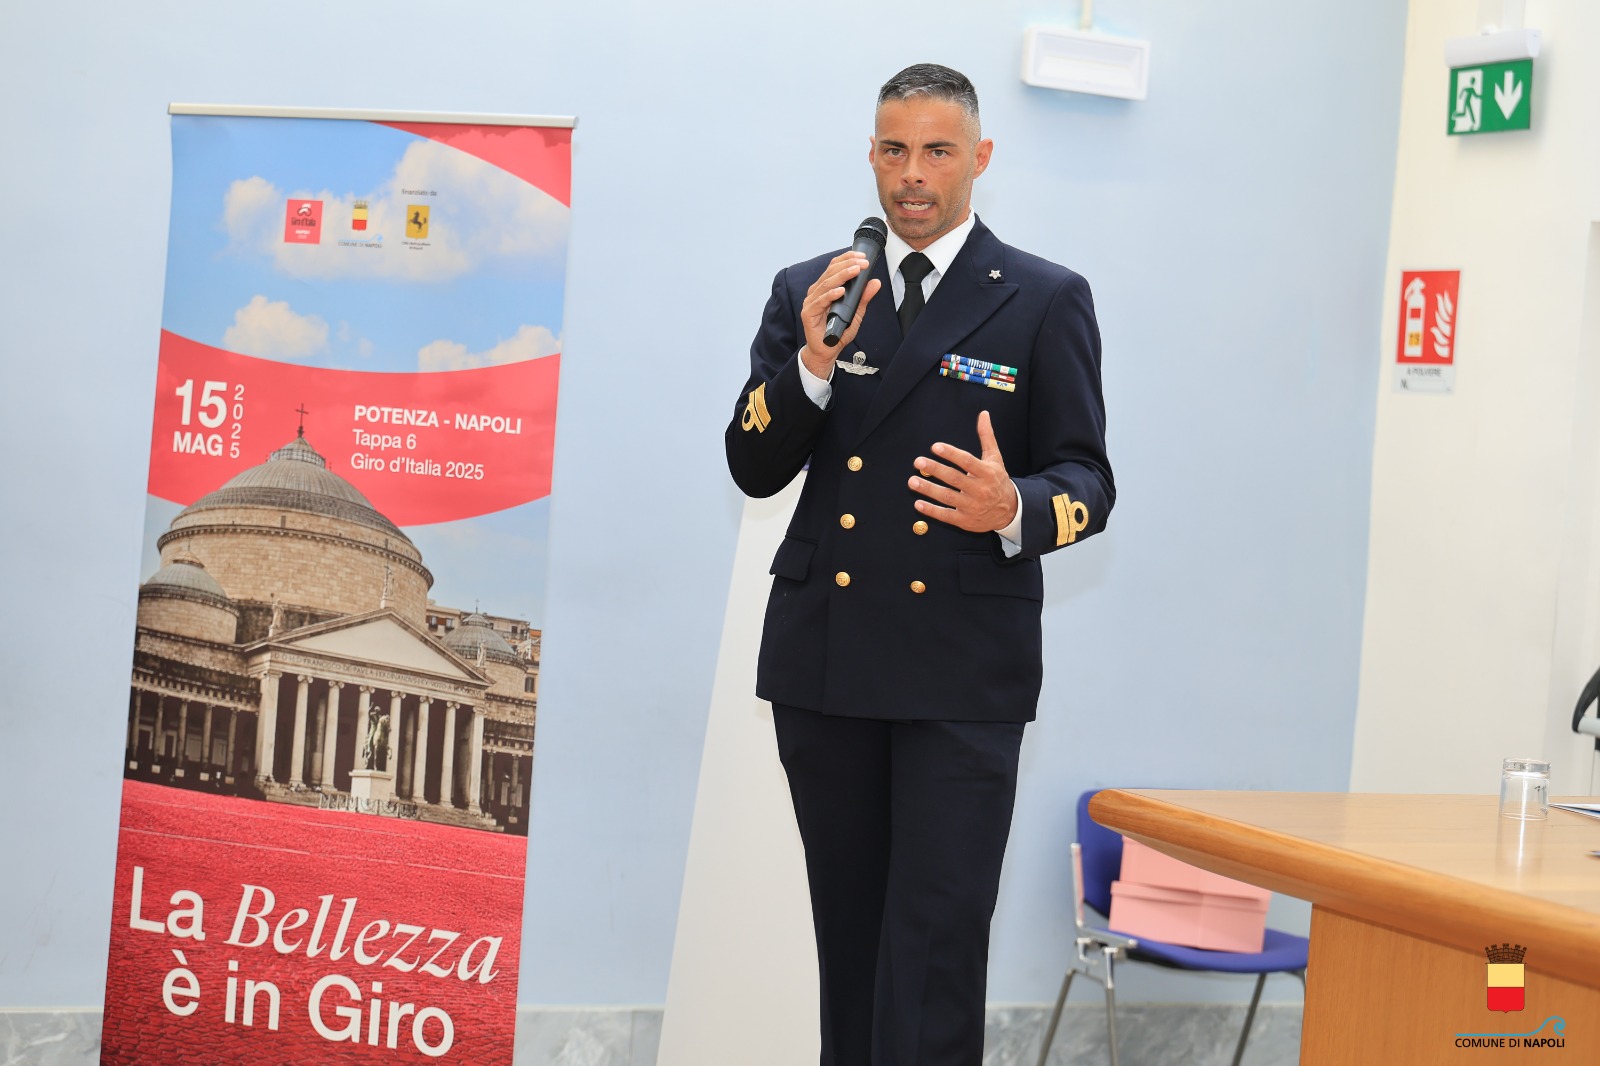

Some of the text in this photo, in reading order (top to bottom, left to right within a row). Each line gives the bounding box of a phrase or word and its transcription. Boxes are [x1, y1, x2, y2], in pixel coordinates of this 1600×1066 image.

[175, 379, 228, 429] 15
[354, 405, 440, 428] POTENZA
[455, 413, 523, 435] NAPOLI
[172, 431, 224, 457] MAG
[352, 429, 417, 450] Tappa 6
[350, 453, 386, 471] Giro
[445, 461, 485, 480] 2025
[129, 866, 503, 985] La Bellezza
[162, 949, 455, 1057] è in Giro
